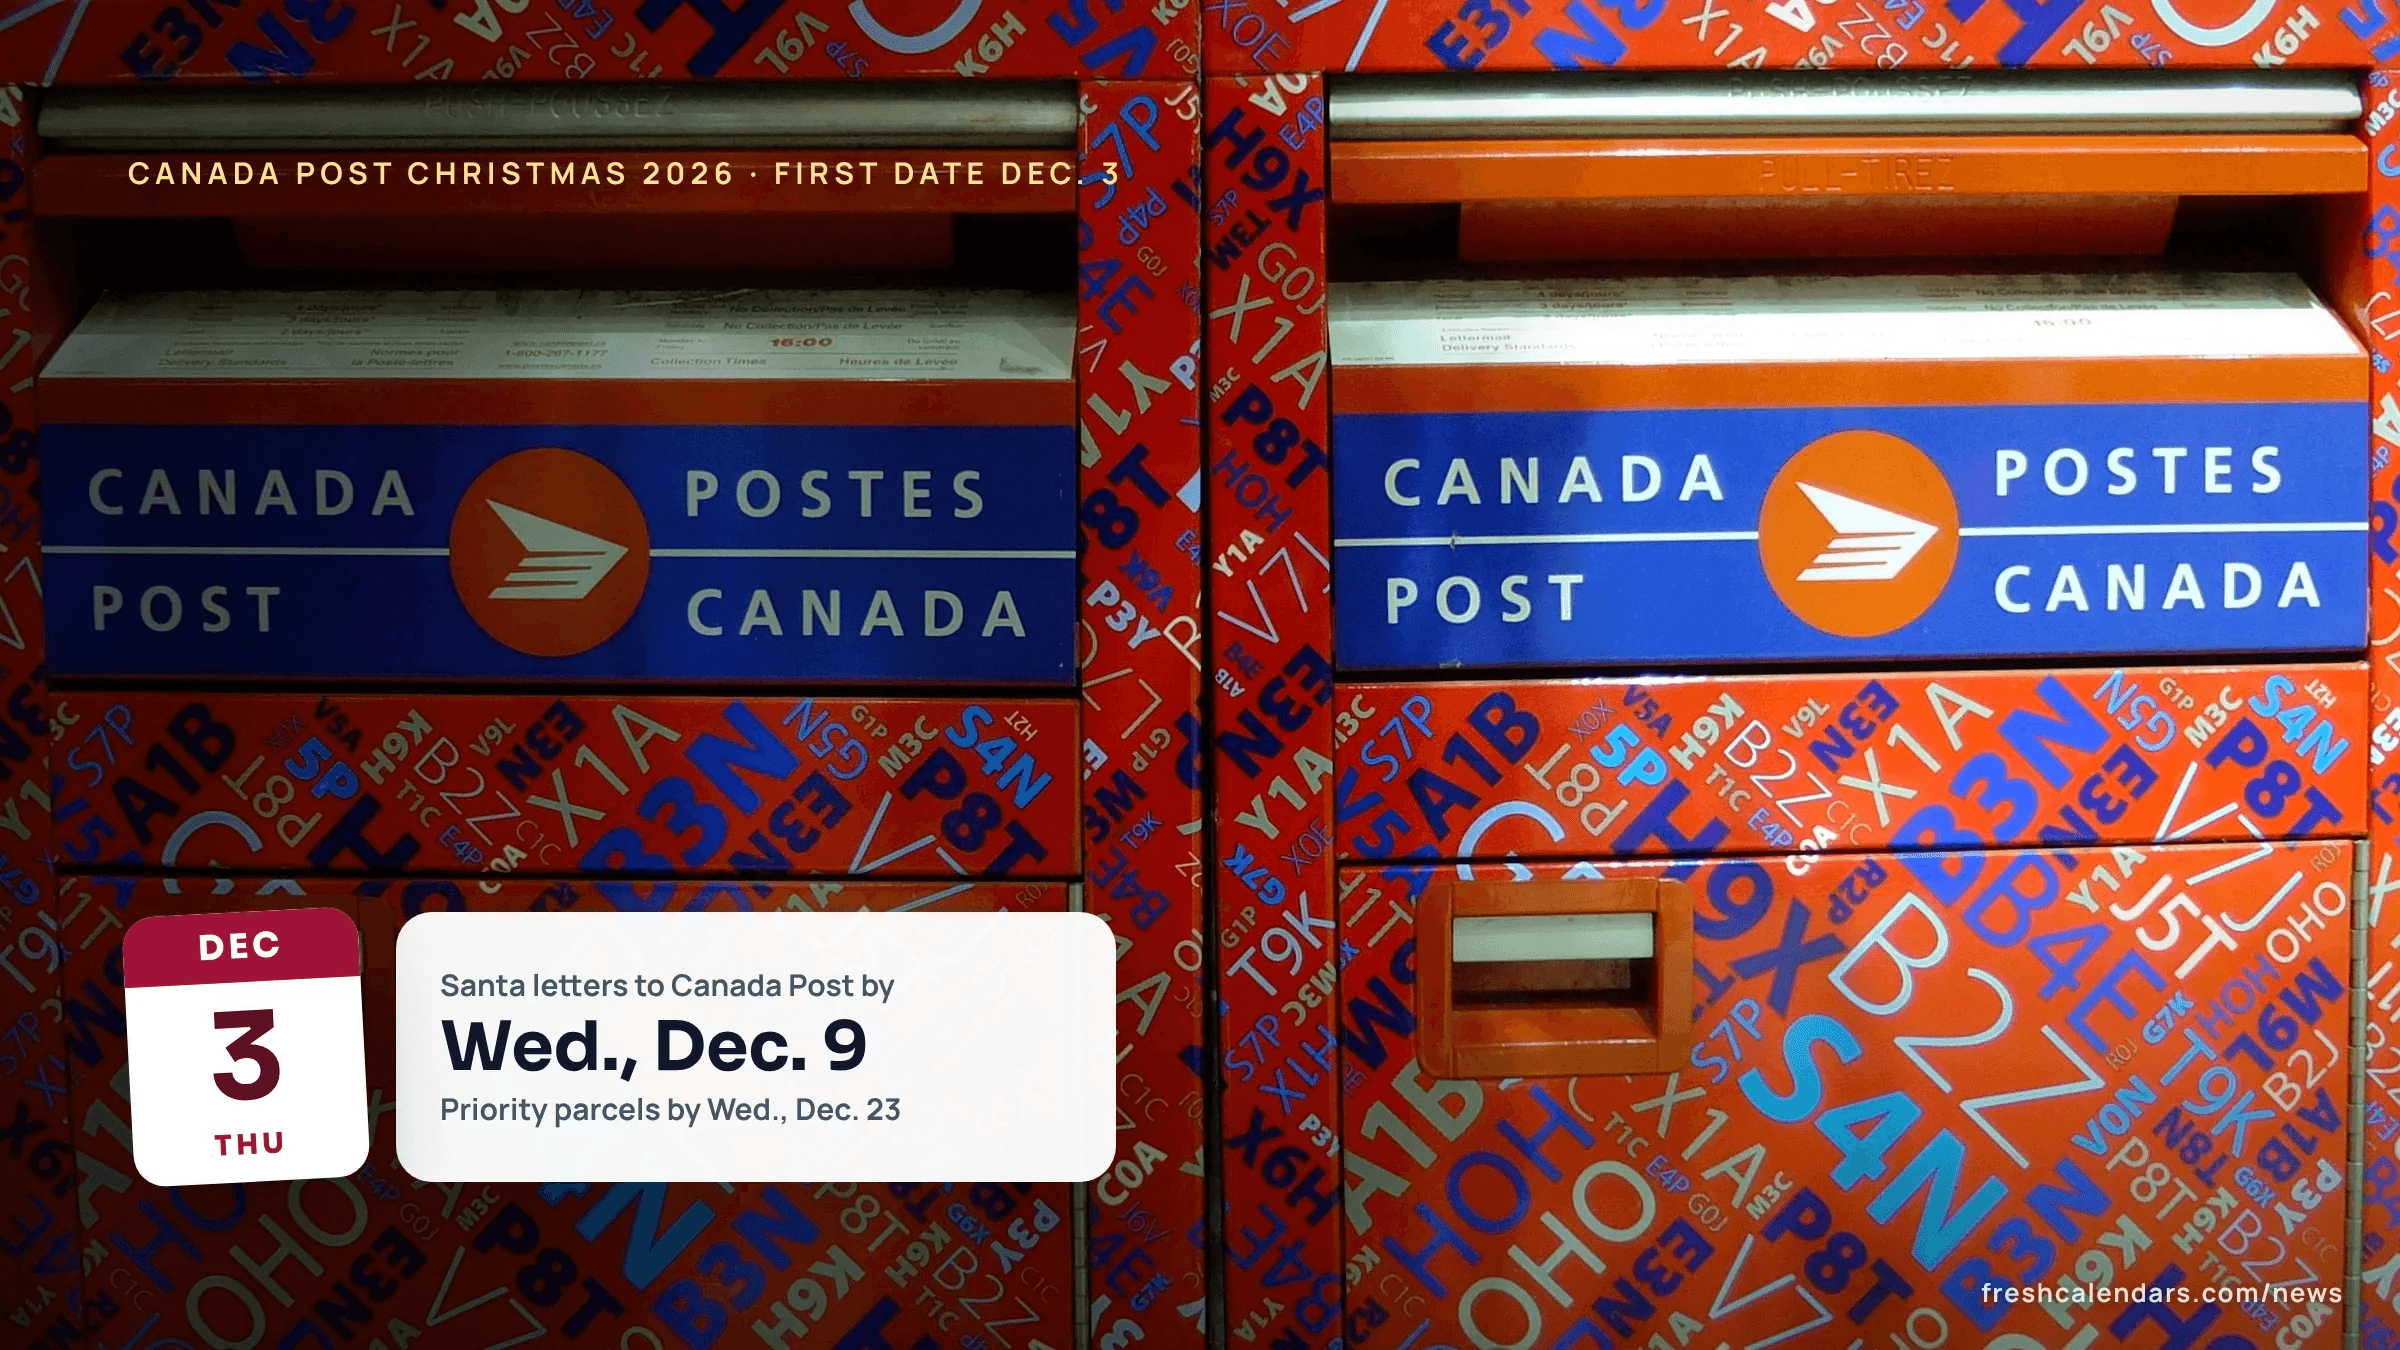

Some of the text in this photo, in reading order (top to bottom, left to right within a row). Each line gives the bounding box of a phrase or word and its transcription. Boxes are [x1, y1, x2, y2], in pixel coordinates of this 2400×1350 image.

[954, 10, 1027, 77] K6H
[2252, 4, 2320, 69] K6H
[1206, 105, 1325, 233] H9X
[158, 358, 287, 367] Delivery Standards
[370, 349, 460, 358] Normes pour
[505, 349, 608, 358] 1-800-267-1177
[650, 357, 767, 366] Collection Times
[770, 338, 832, 348] 16:00
[840, 358, 890, 366] Heures
[894, 358, 912, 366] de
[1207, 271, 1328, 412] X1A
[1442, 344, 1500, 352] Delivery
[1208, 366, 1242, 404] M3C
[1221, 382, 1329, 490] P8T
[89, 469, 983, 518] CANADA POSTES
[1384, 446, 2282, 506] CANADA POSTES
[1211, 528, 1266, 579] Y1A
[93, 585, 1026, 637] POST CANADA
[1085, 579, 1162, 651] P3Y
[1386, 562, 2321, 624] POST CANADA
[849, 704, 889, 740] G1P
[1781, 697, 1831, 739] V9L
[2158, 676, 2195, 711] G1P
[2182, 685, 2244, 748] M3C
[2247, 673, 2350, 775] S4N
[65, 702, 136, 789] S7P
[468, 716, 517, 758] V9L
[876, 713, 941, 779] M3C
[944, 704, 1054, 810] S4N
[1360, 694, 1434, 783] S7P
[1406, 690, 1542, 842] A1B
[1837, 682, 1995, 828] X1A
[111, 701, 236, 846] A1B
[396, 778, 443, 829] T1C
[412, 736, 522, 846] B2Z
[525, 702, 683, 850] X1A
[577, 698, 802, 912] B3N
[1233, 745, 1334, 841] Y1A
[1706, 762, 1752, 813] T1C
[1723, 719, 1833, 829] B2Z
[1887, 674, 2112, 907] B3N
[2205, 716, 2345, 850] P8T
[899, 745, 1048, 879] P8T
[1119, 810, 1164, 850] T9K
[1747, 807, 1793, 848] E4P
[1826, 800, 1873, 846] C1C
[2064, 847, 2148, 915] Y1A
[1219, 905, 1257, 949] G1P
[1226, 889, 1337, 997] T9K
[1961, 848, 2169, 1055] B4E
[2108, 873, 2239, 981] J5T
[1224, 1012, 1281, 1083] S7P
[1690, 997, 1763, 1085] S7P
[1827, 891, 2107, 1170] B2Z
[2141, 988, 2195, 1045] G7K
[2159, 1026, 2276, 1158] T9K
[2262, 1028, 2340, 1112] B2J
[1604, 1109, 1650, 1160] T1C
[1630, 1072, 1767, 1210] X1A
[1737, 1012, 2010, 1273] S4N
[454, 1184, 502, 1233] M3C
[1645, 1152, 1691, 1194] E4P
[1744, 1170, 1794, 1222] M3C
[2104, 1134, 2199, 1221] P8T
[473, 1201, 627, 1340] P8T
[652, 1183, 823, 1350] B3N
[1761, 1186, 1916, 1326] P8T
[1939, 1157, 2113, 1334] B3N
[915, 1284, 961, 1333] T1C
[932, 1244, 1041, 1350] B2Z
